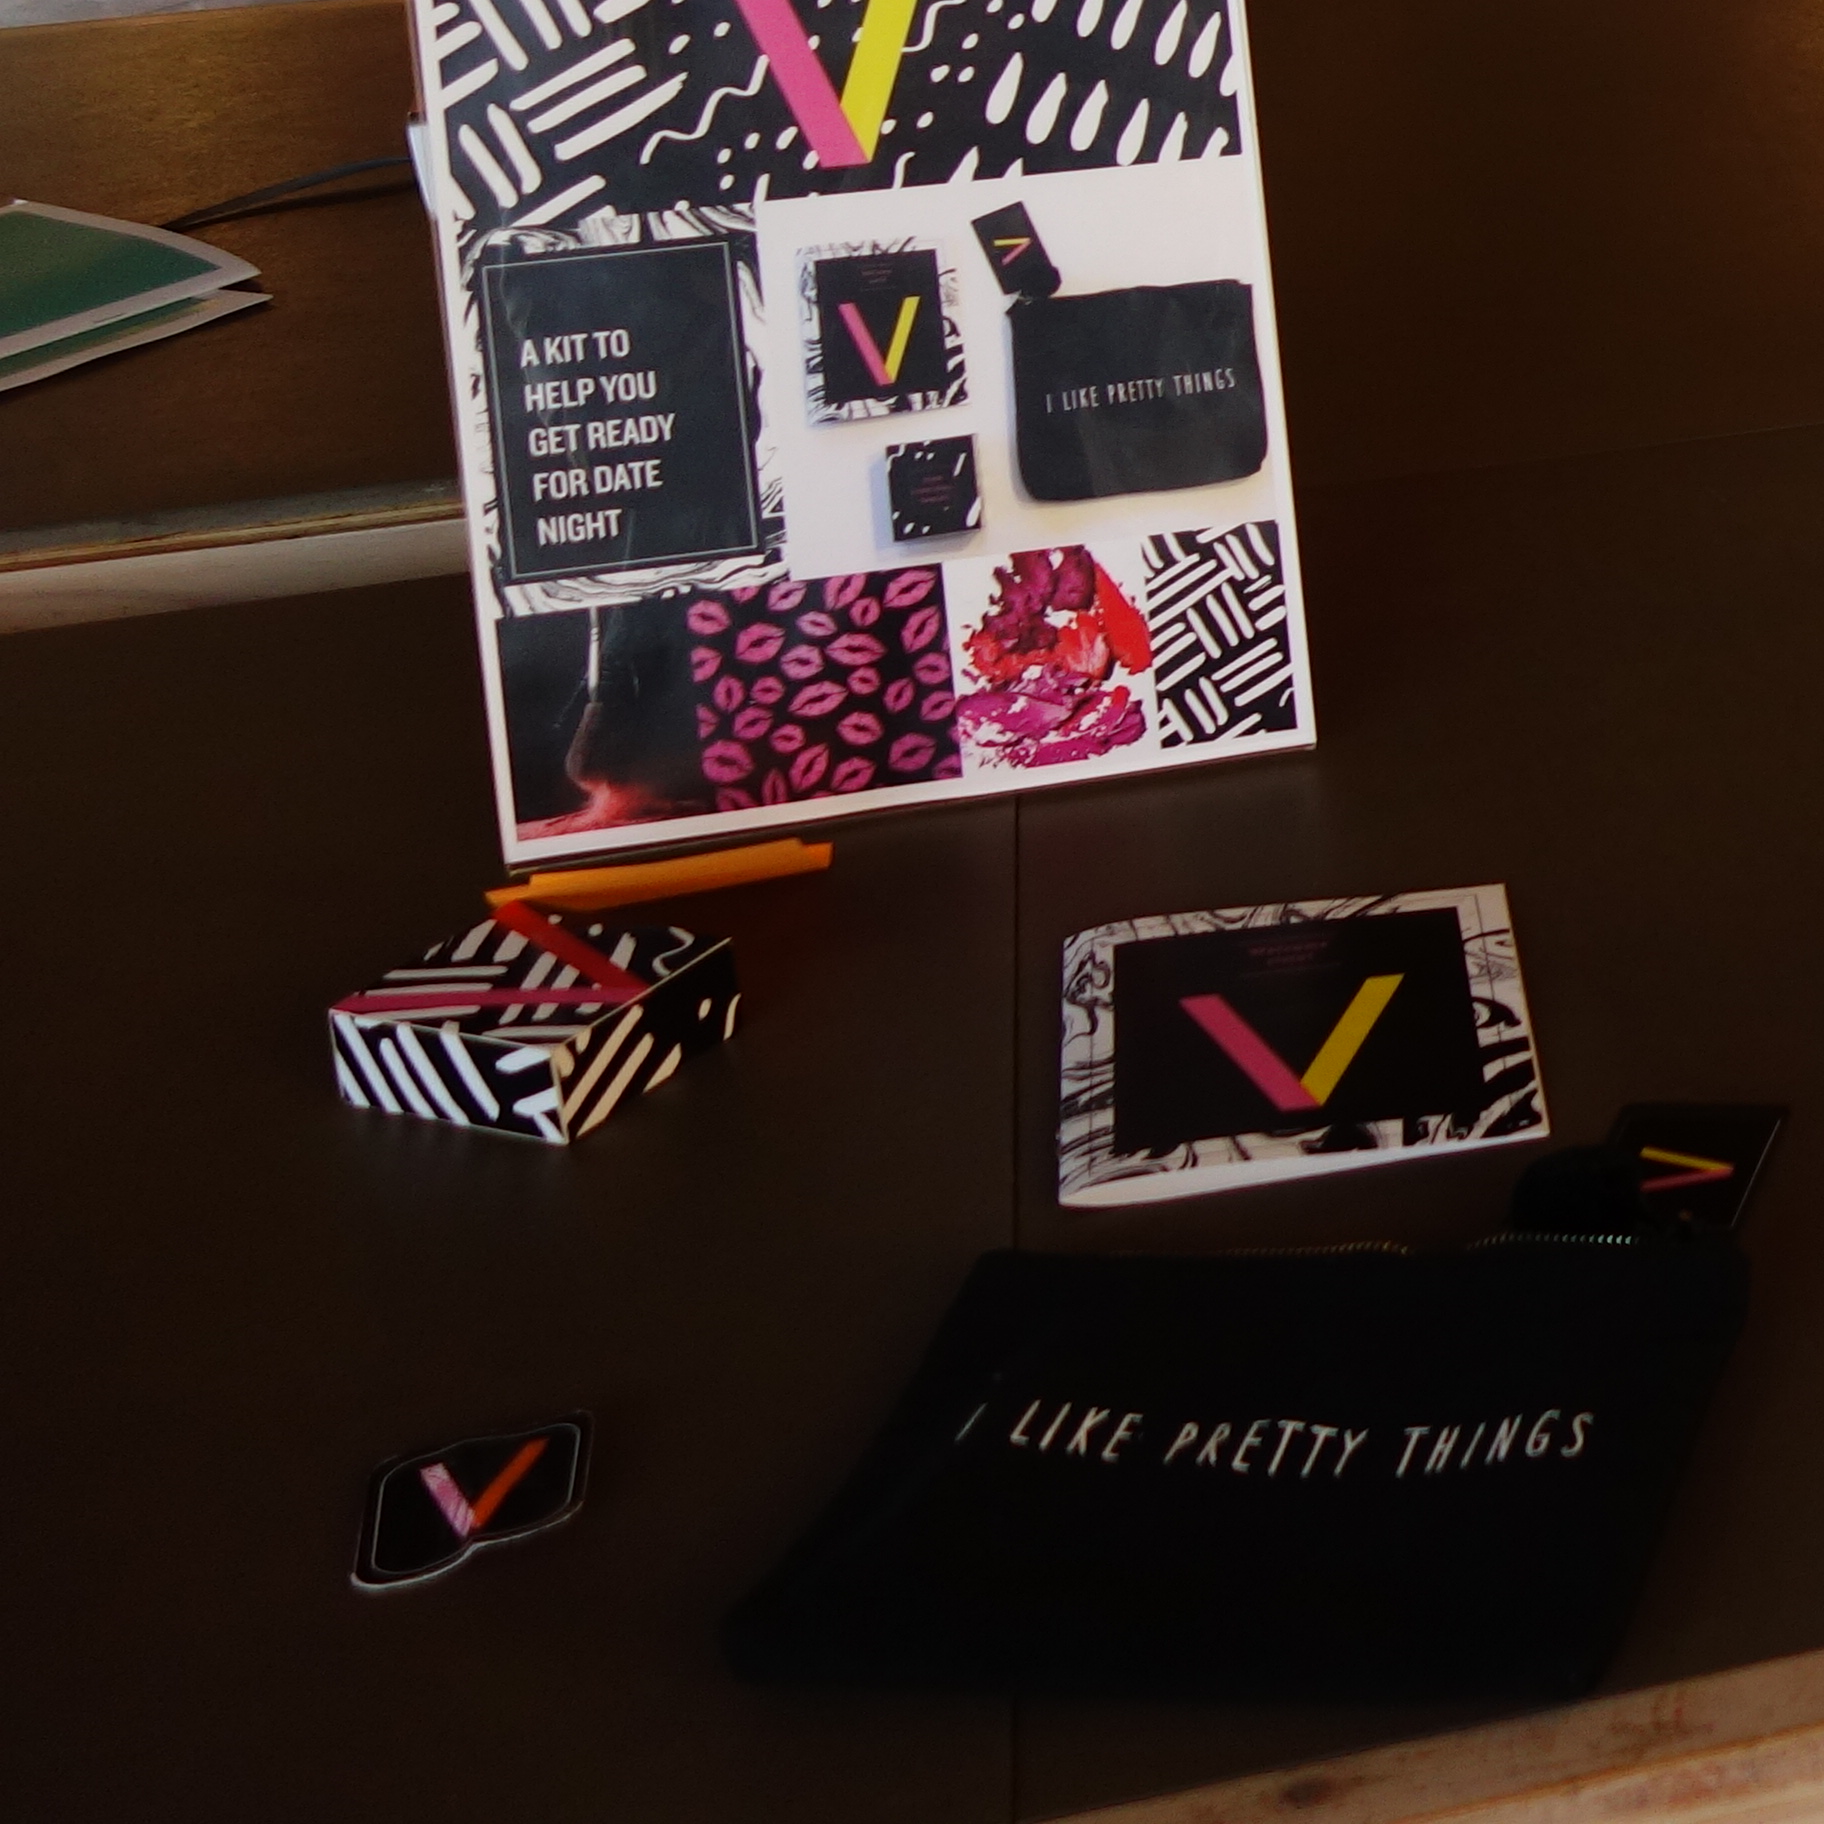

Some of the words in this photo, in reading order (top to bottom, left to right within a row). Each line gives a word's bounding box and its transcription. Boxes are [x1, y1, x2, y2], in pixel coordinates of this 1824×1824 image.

[520, 338, 540, 369] A
[544, 333, 588, 365] KIT
[592, 328, 631, 360] TO
[838, 295, 921, 386] V
[524, 378, 596, 413] HELP
[600, 370, 656, 405] YOU
[1046, 393, 1053, 414] I
[1062, 386, 1100, 412] LIKE
[1107, 378, 1165, 405] PRETTY
[1172, 367, 1236, 397] THINGS
[529, 424, 581, 457] GET
[587, 413, 675, 451] READY
[533, 468, 589, 502] FOR
[593, 459, 663, 494] DATE
[537, 509, 622, 546] NIGHT
[955, 1403, 987, 1442] I
[1009, 1399, 1143, 1463] LIKE
[1163, 1419, 1368, 1477] PRETTY
[1396, 1408, 1594, 1477] THINGS
